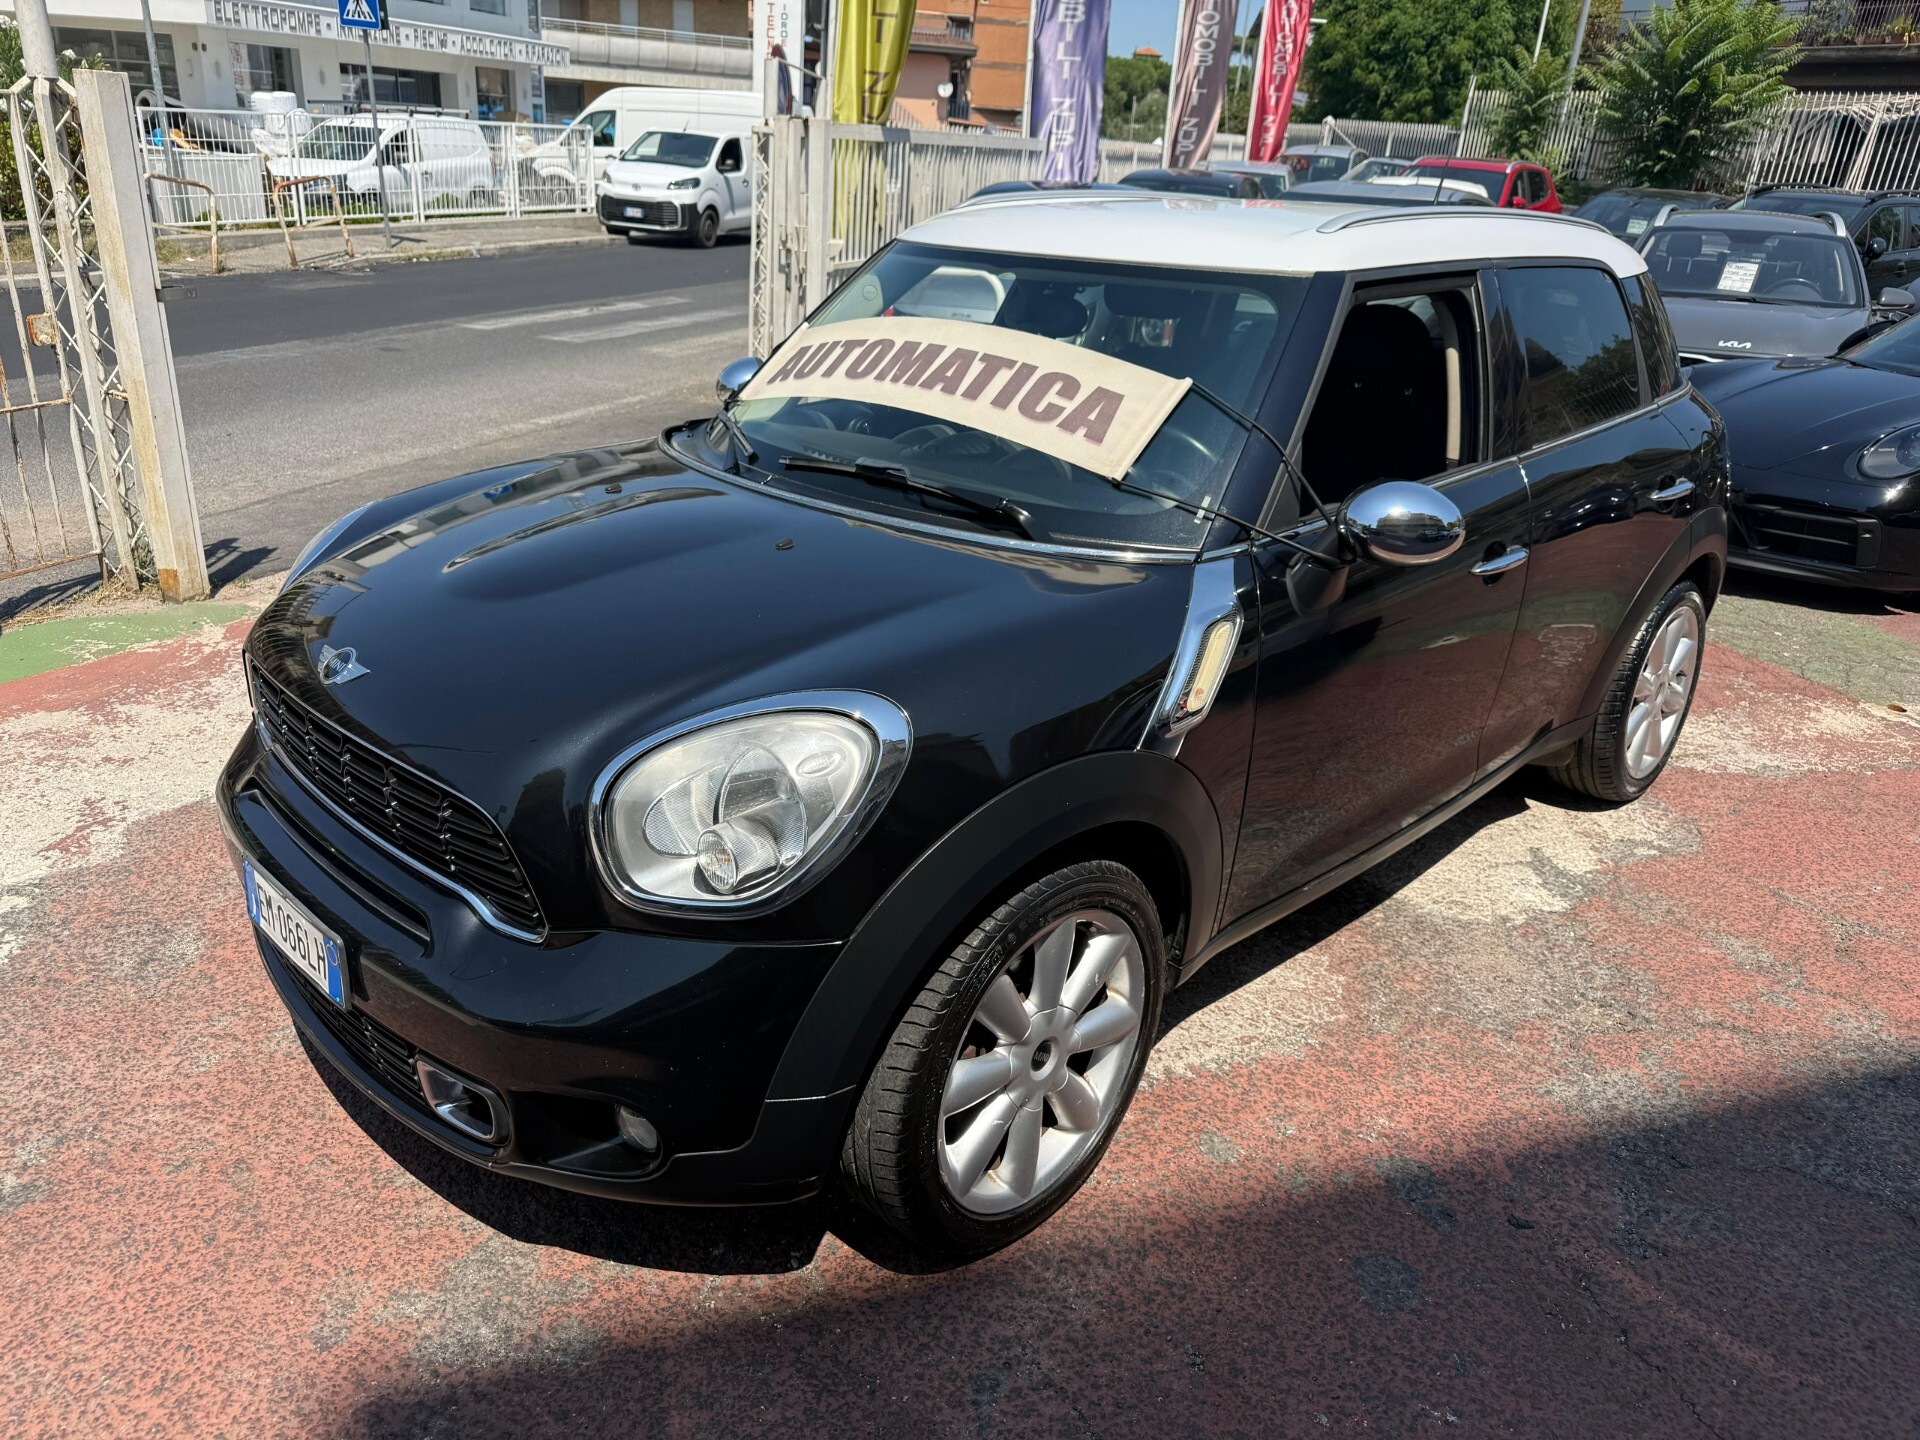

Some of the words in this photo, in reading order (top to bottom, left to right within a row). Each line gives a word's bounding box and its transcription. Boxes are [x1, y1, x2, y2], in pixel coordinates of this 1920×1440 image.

[214, 0, 322, 36] ELETTROPOMPE
[1056, 0, 1086, 79] BILI
[1176, 117, 1200, 168] ZUPI
[767, 338, 1125, 446] AUTOMATICA
